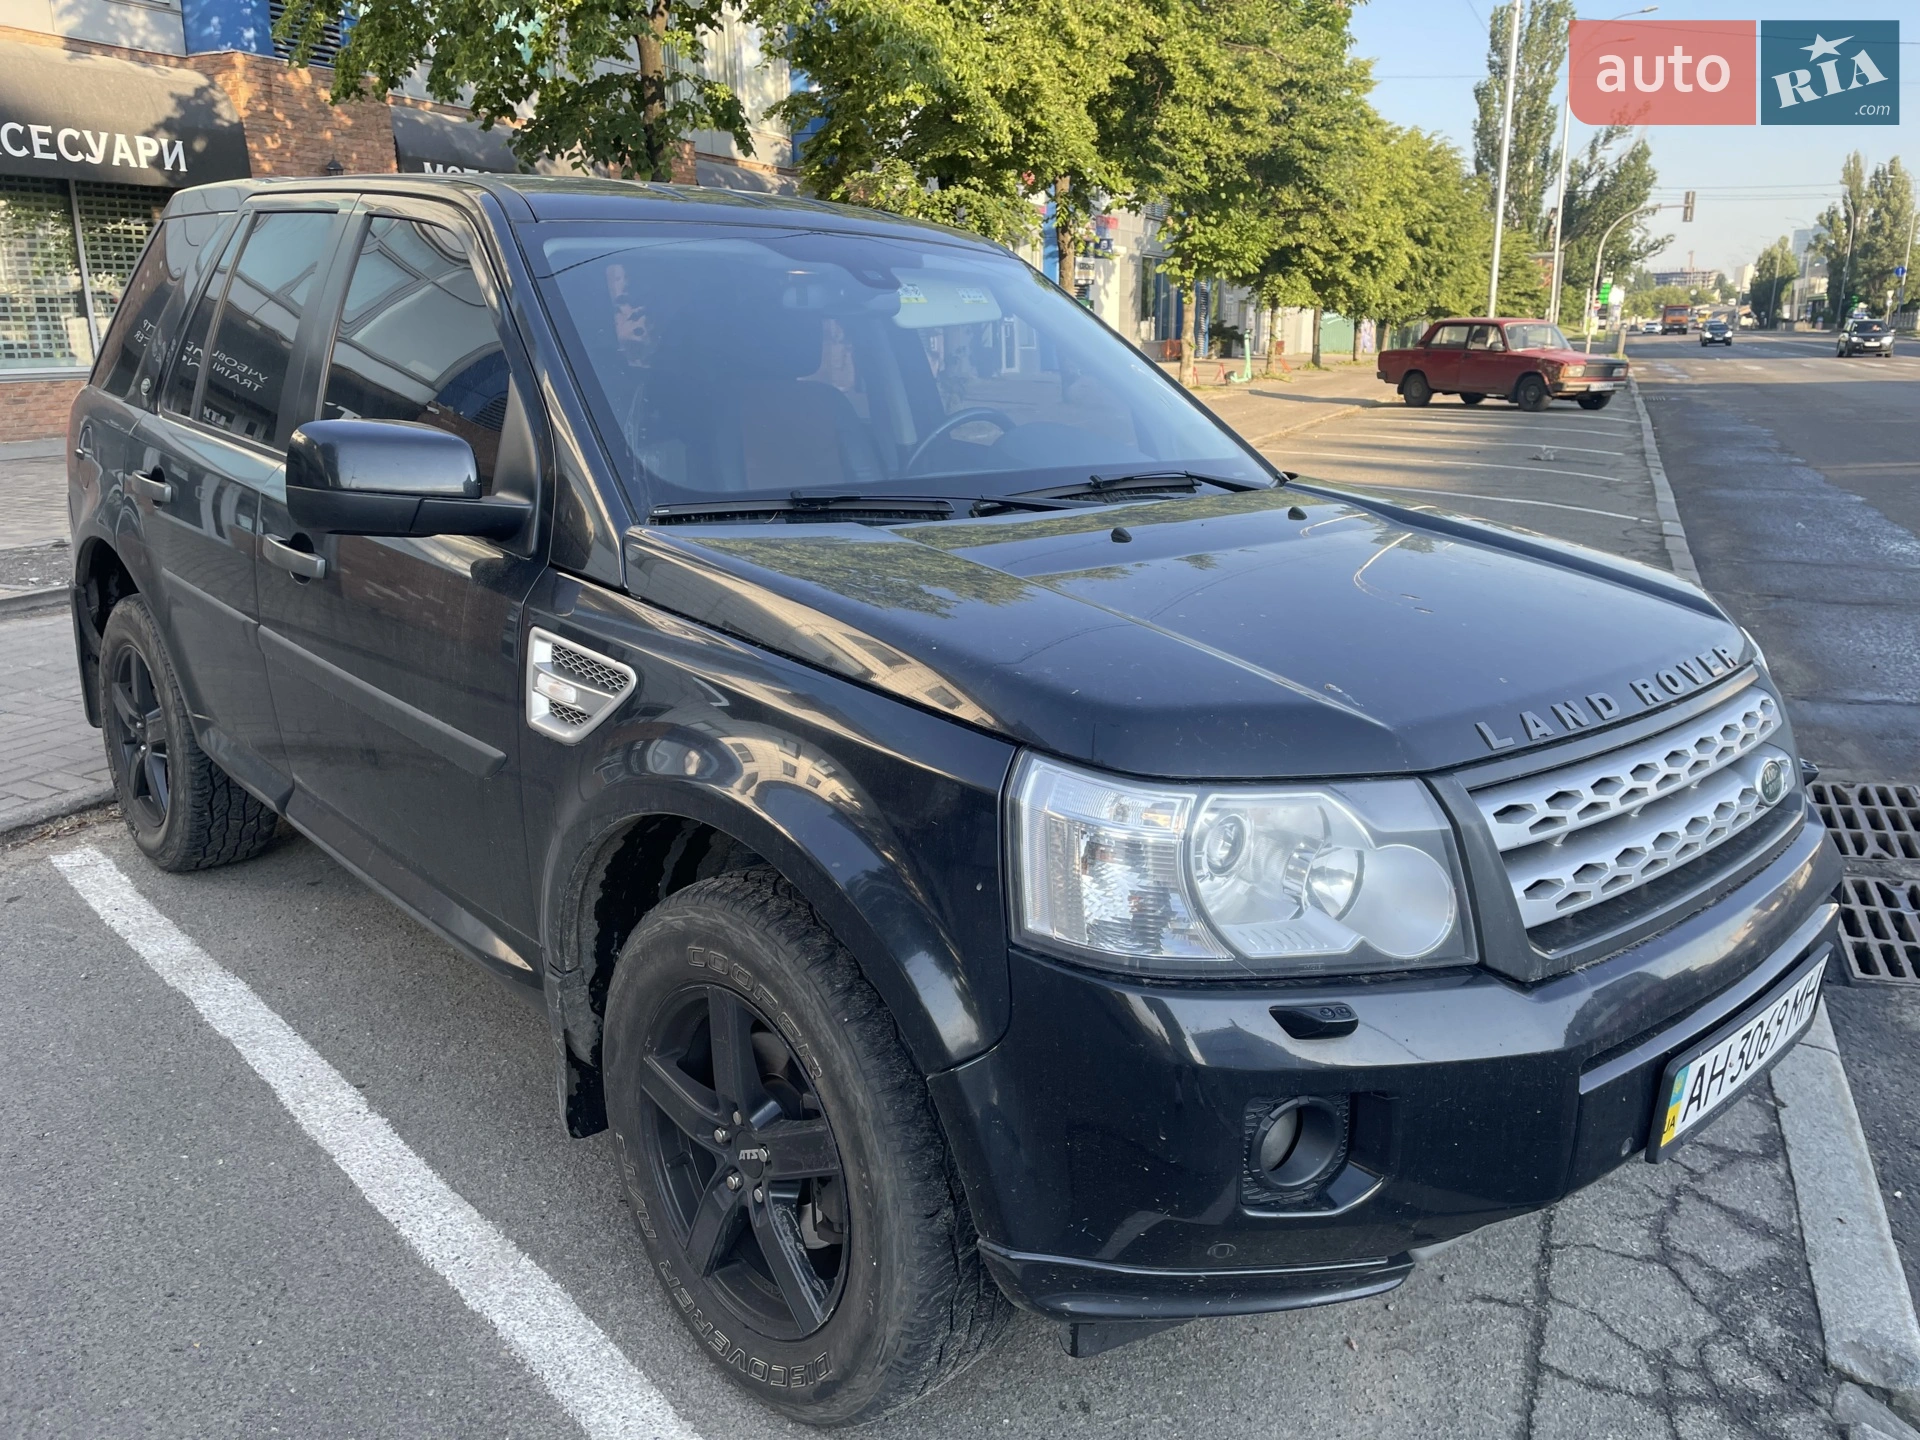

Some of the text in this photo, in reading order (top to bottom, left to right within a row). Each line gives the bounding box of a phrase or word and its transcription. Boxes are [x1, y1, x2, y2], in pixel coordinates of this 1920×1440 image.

[0, 121, 188, 172] СЕСУАРИ
[1475, 644, 1739, 750] LAND ROVER
[687, 945, 823, 1080] COOPER
[738, 1148, 759, 1161] ATS
[658, 1259, 833, 1389] DISCOVERER
